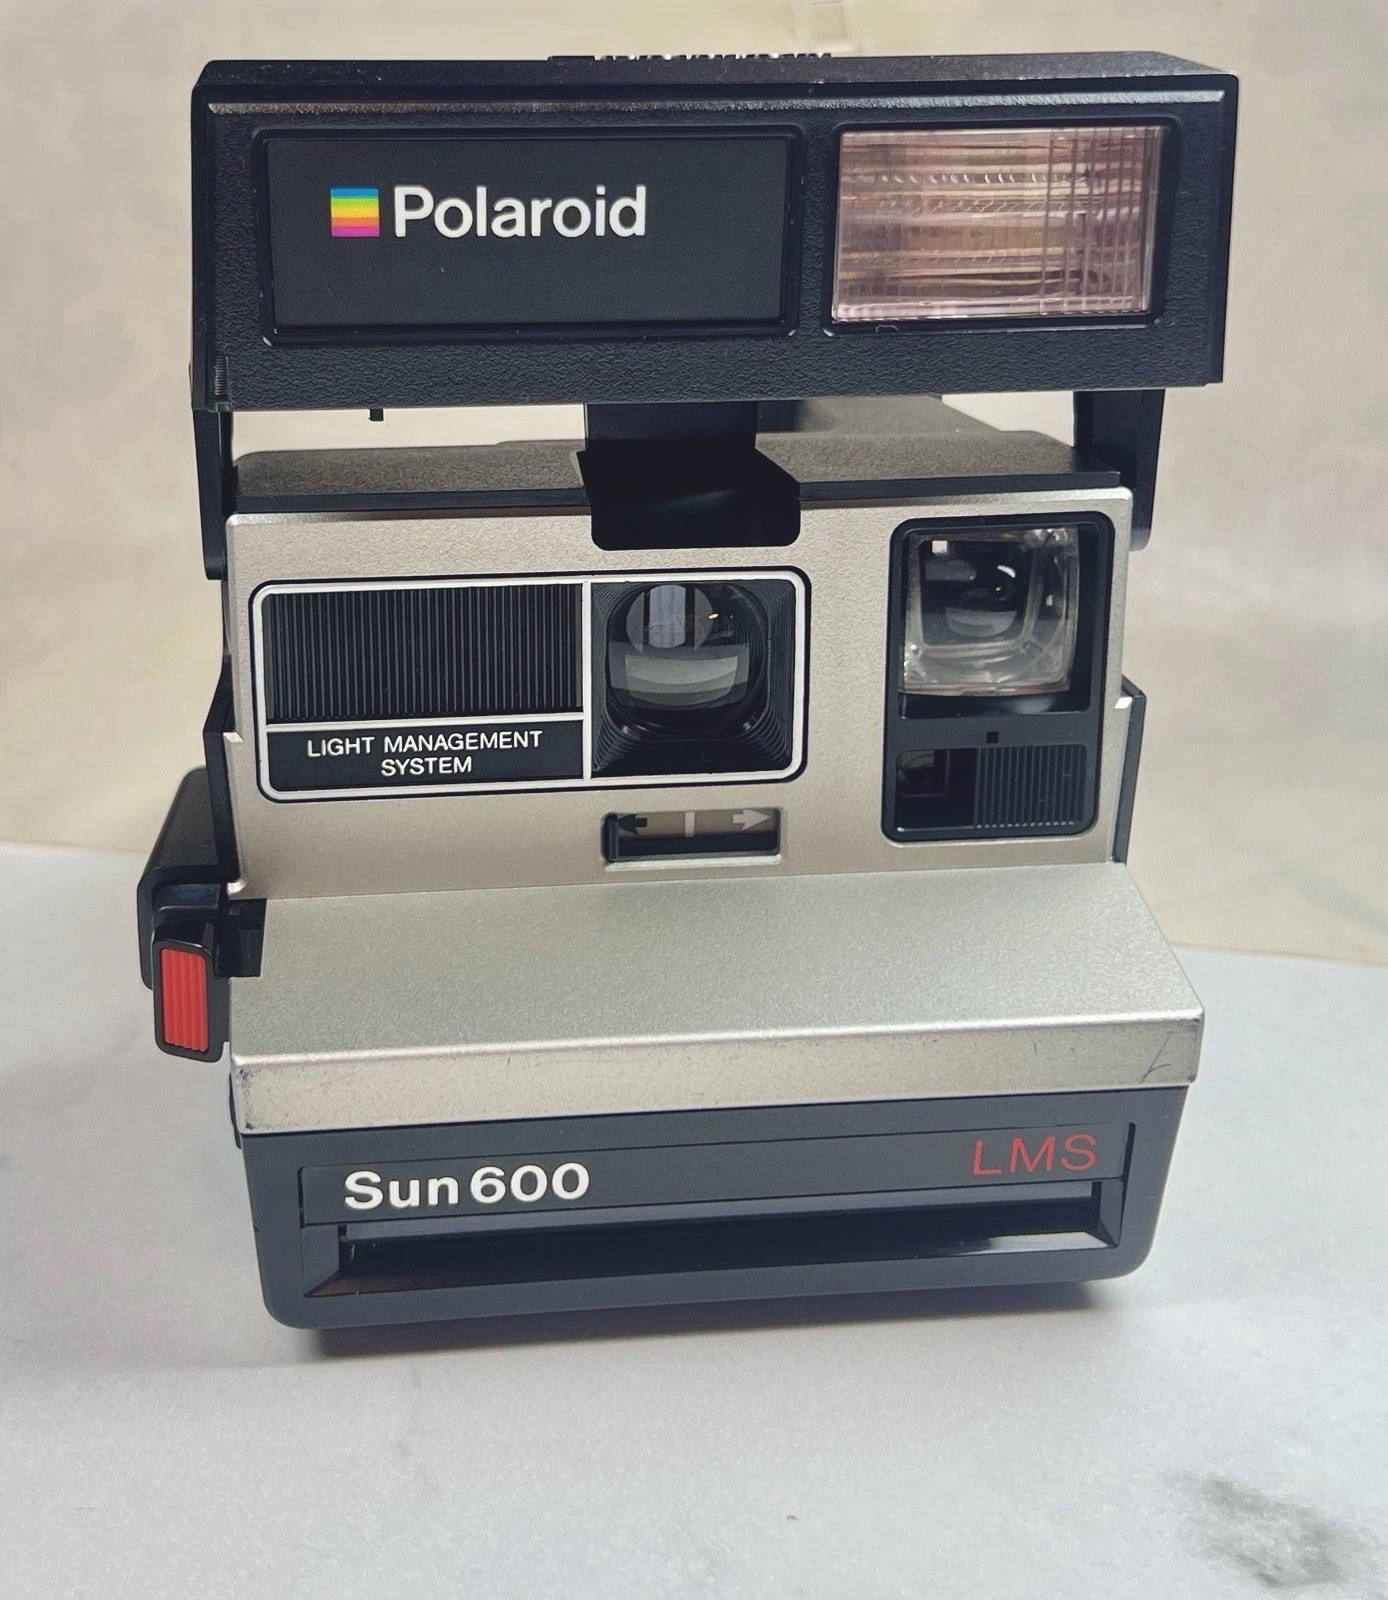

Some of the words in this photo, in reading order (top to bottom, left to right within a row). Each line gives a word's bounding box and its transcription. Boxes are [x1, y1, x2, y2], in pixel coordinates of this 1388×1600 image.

[394, 184, 647, 238] Polaroid
[307, 736, 375, 758] LIGHT
[383, 730, 543, 753] MANAGEMENT
[380, 756, 473, 777] SYSTEM
[973, 1133, 1098, 1176] LMS
[344, 1170, 460, 1210] Sun
[470, 1162, 590, 1204] 600
